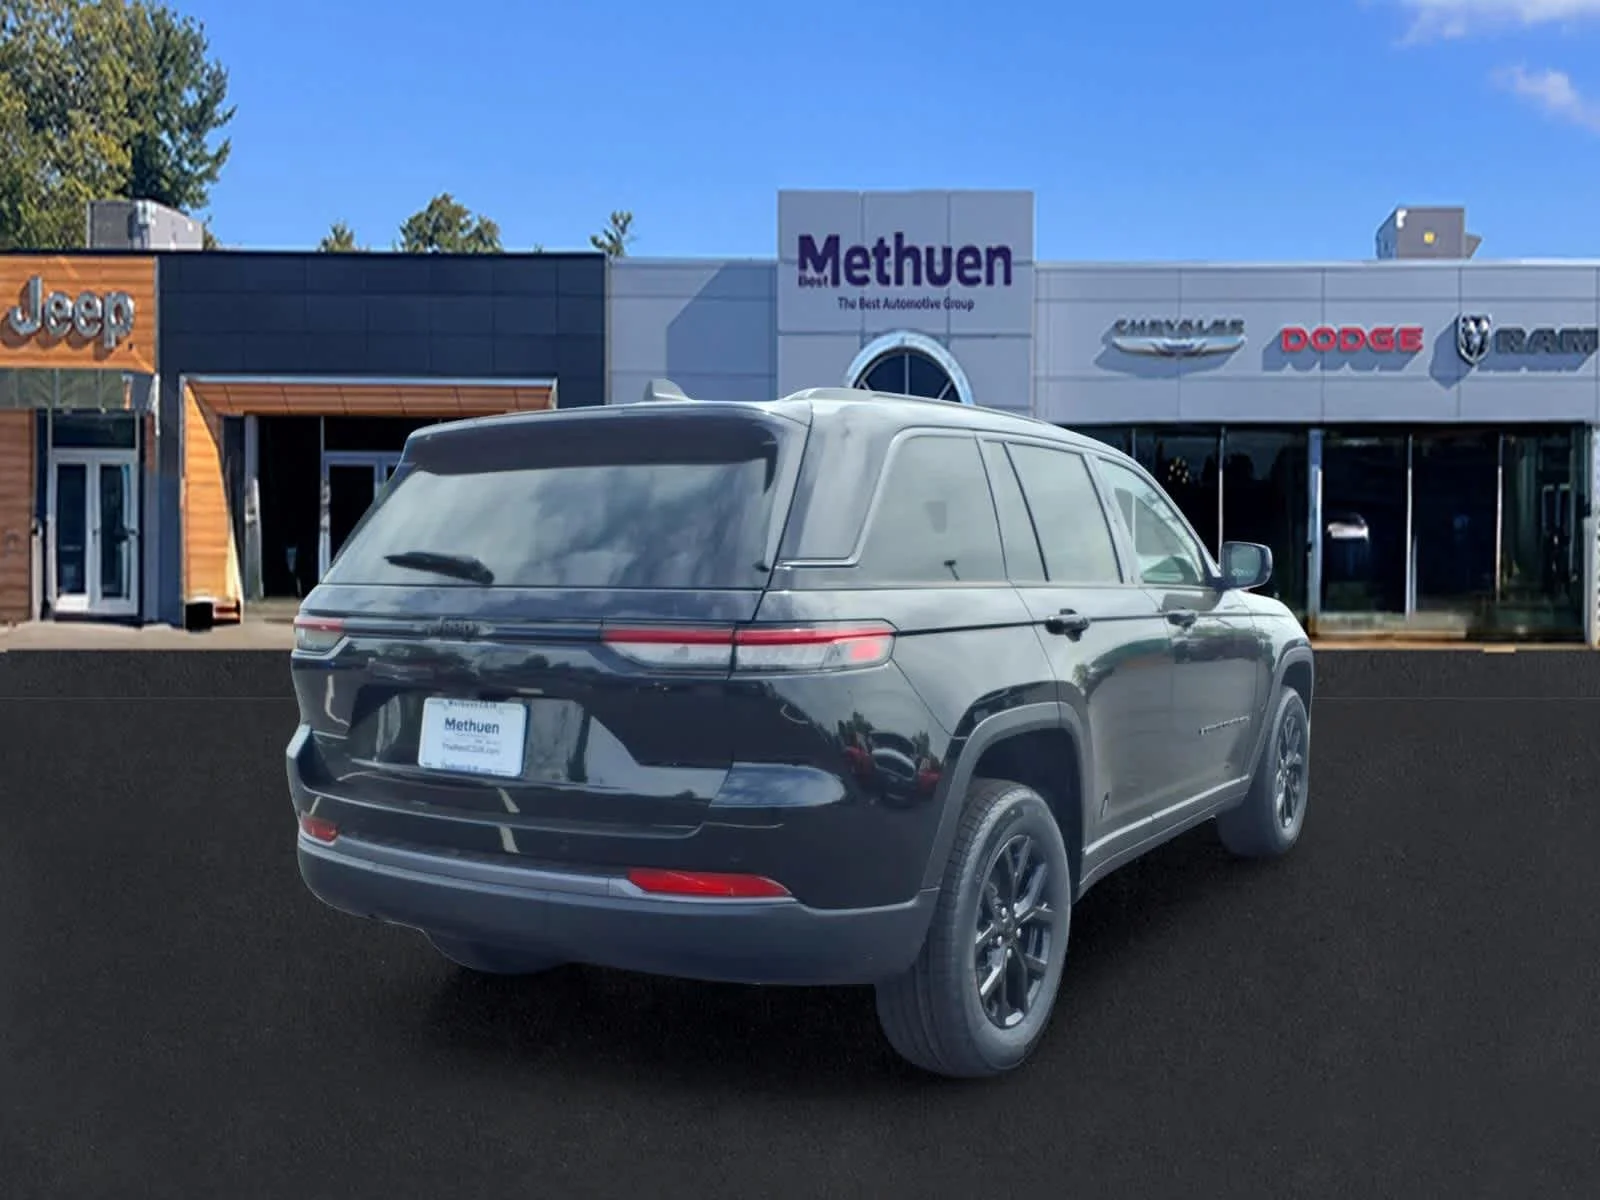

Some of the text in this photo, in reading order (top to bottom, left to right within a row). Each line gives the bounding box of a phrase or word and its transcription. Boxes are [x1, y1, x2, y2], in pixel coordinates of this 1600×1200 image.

[798, 232, 1012, 287] Methuen
[9, 276, 134, 349] Jeep
[838, 297, 975, 312] The Best Automotive Group
[1281, 327, 1423, 352] DODGE
[1495, 328, 1599, 354] RAM
[445, 717, 499, 734] Methuen
